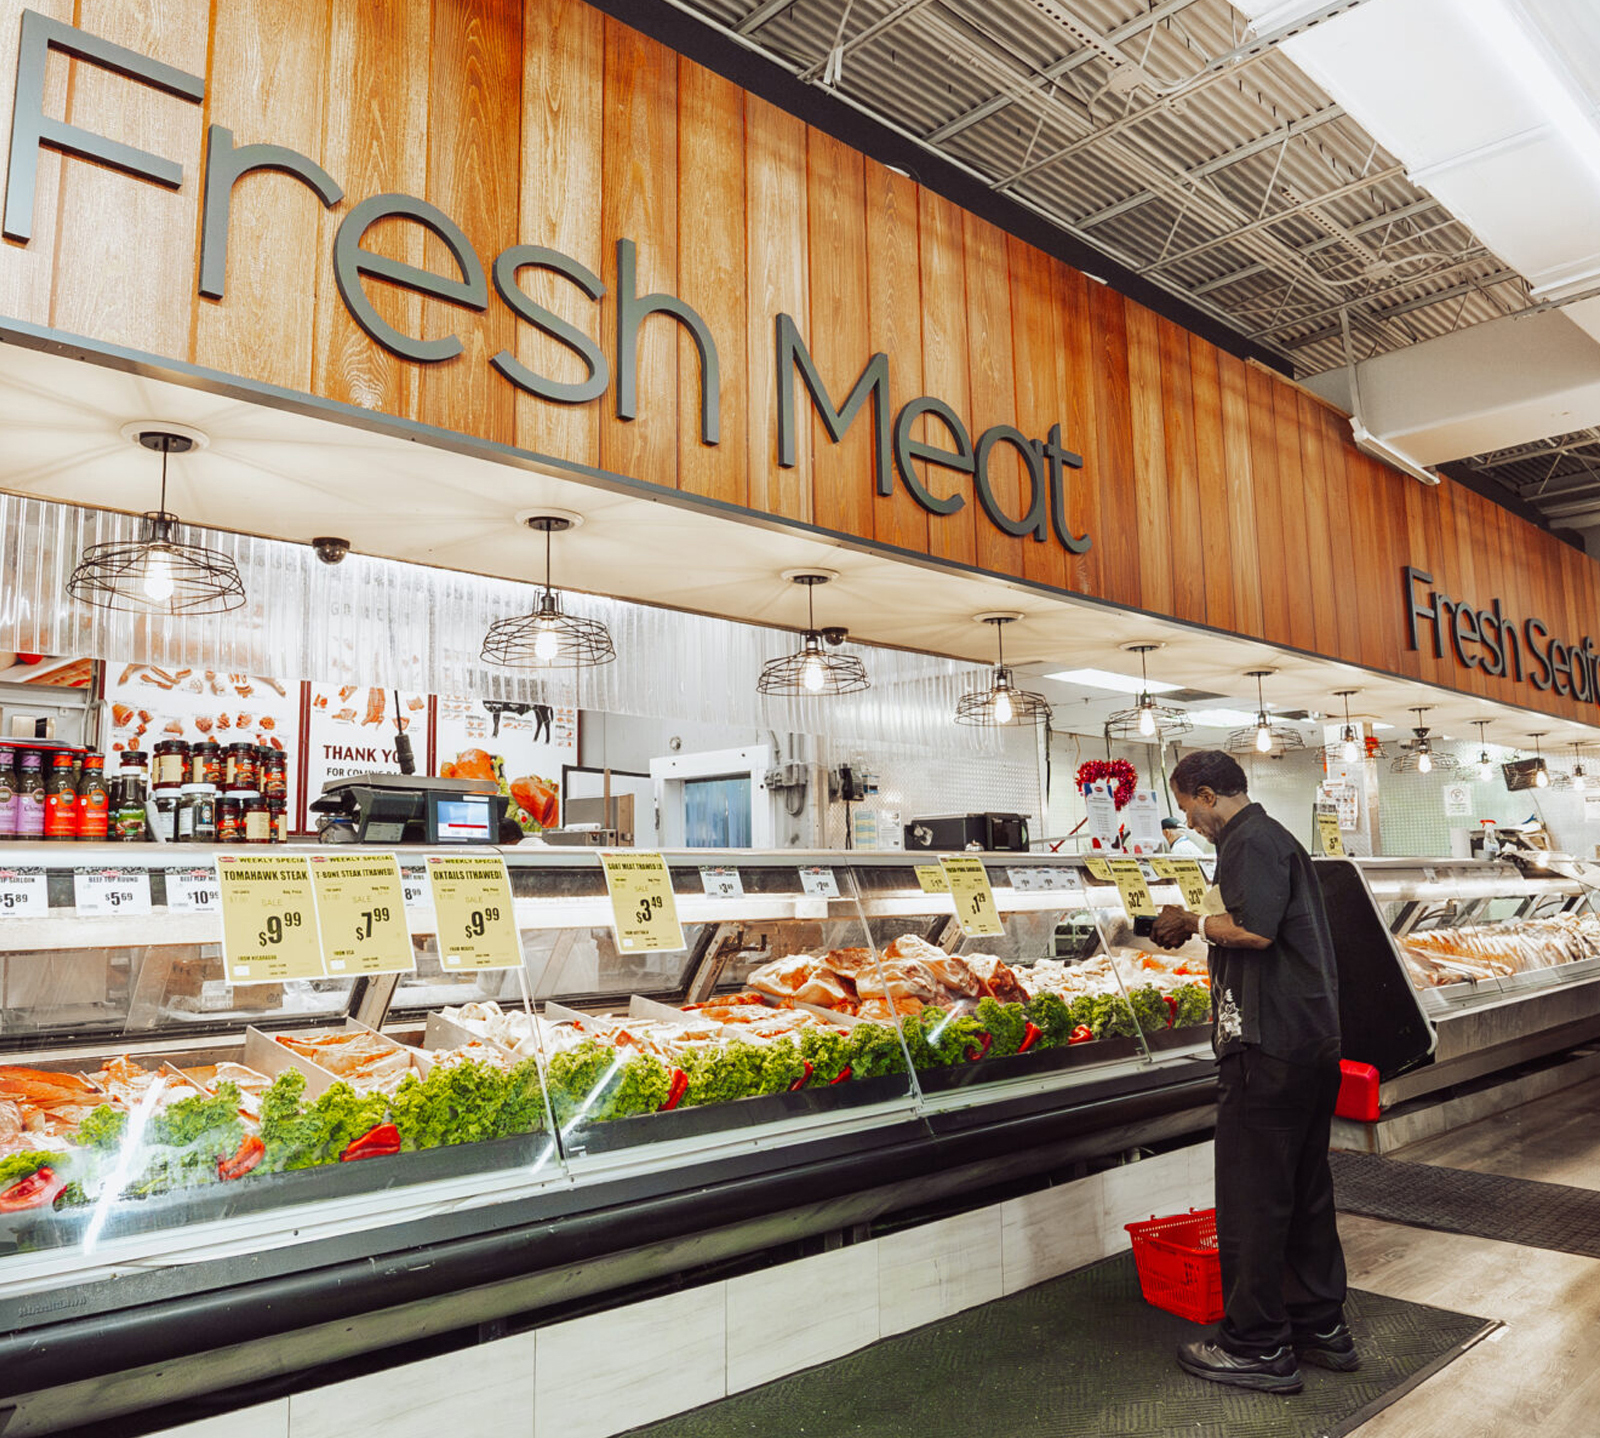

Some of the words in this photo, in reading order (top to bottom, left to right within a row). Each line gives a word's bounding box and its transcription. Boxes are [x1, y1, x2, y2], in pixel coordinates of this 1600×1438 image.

[2, 8, 720, 446] Fresh
[775, 312, 1093, 554] Meat
[1402, 565, 1524, 683] Fresh
[323, 744, 377, 763] THANK
[381, 748, 400, 764] YO
[326, 767, 344, 777] FOR
[223, 870, 279, 881] TOMAHAWK
[280, 870, 308, 881] STEAK
[433, 871, 465, 880] OXTAILS
